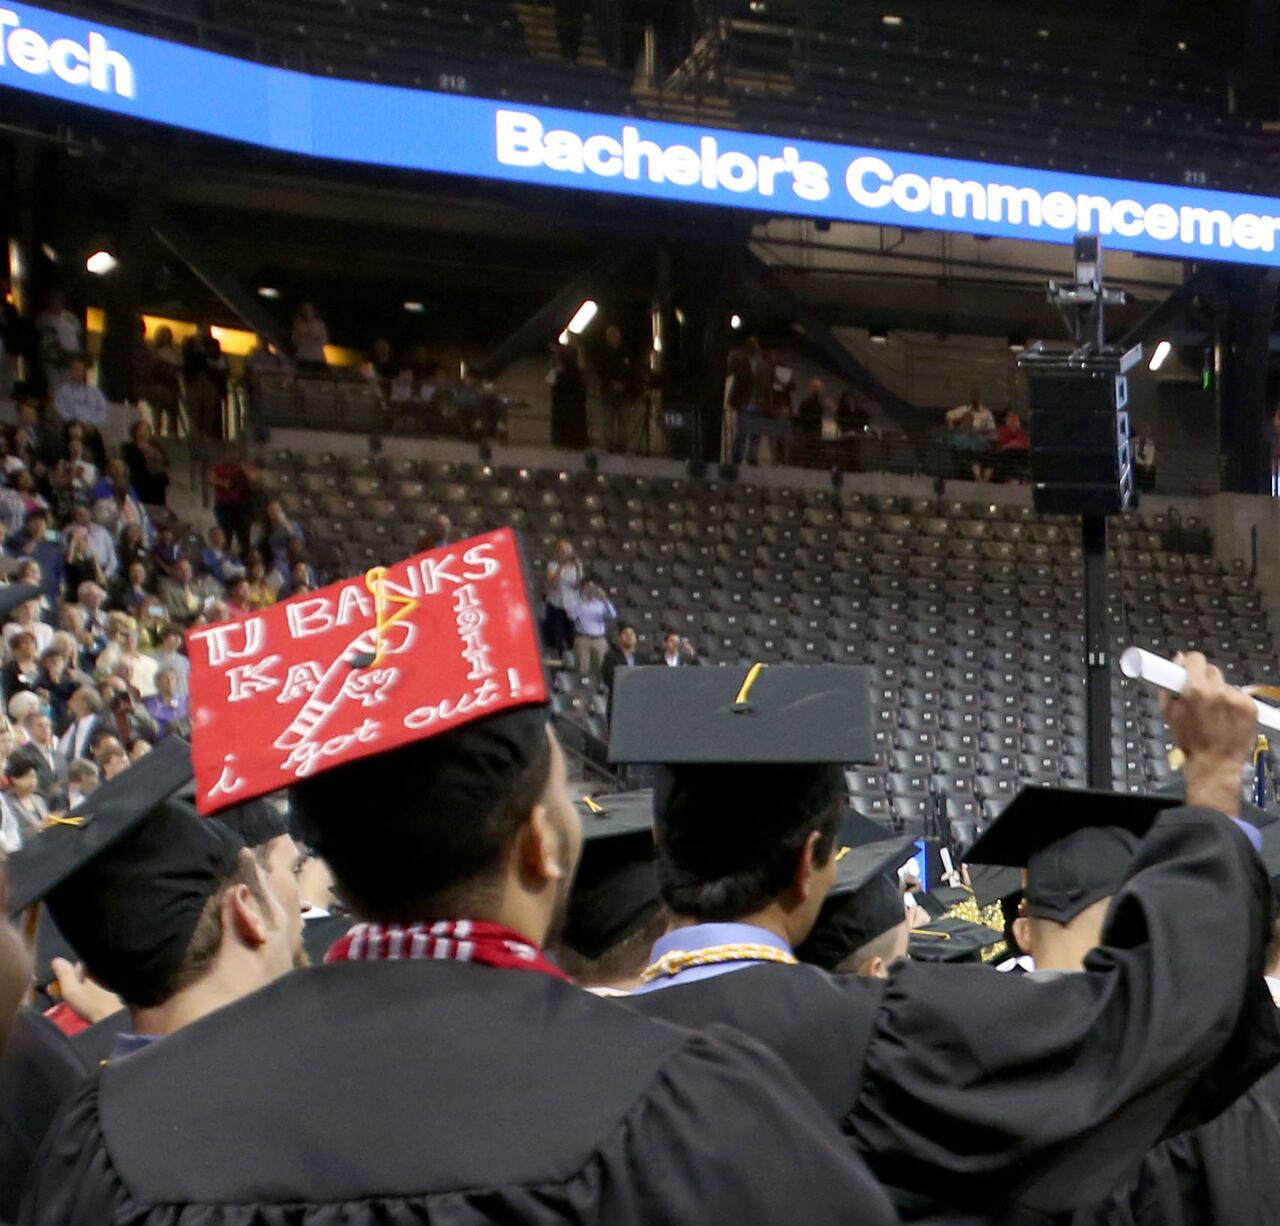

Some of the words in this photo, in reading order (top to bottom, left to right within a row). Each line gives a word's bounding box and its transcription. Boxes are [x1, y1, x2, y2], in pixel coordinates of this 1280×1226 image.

[495, 109, 830, 201] Bachelor's
[189, 616, 267, 667] TJ
[285, 542, 502, 639] BANKS
[280, 718, 384, 777] got
